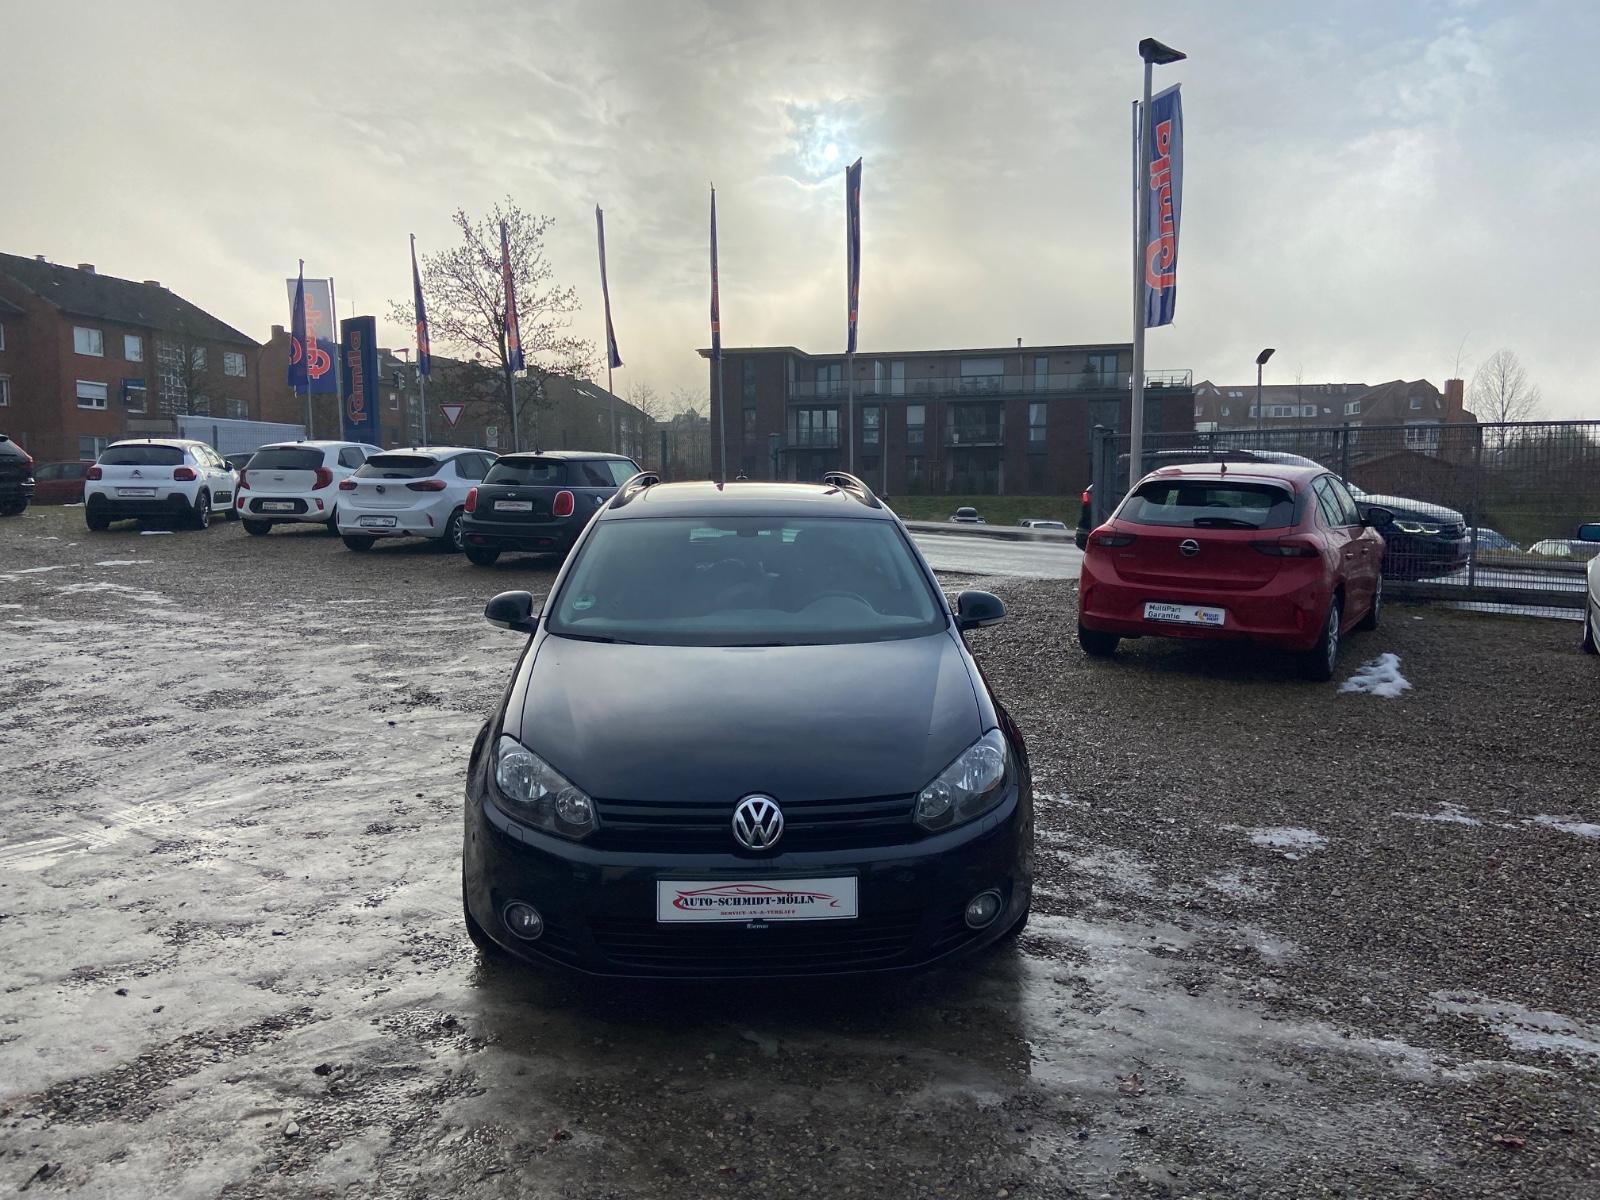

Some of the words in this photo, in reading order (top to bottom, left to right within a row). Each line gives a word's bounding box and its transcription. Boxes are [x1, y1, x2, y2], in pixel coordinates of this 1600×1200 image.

[348, 332, 368, 425] famila
[1148, 611, 1181, 619] Garantie
[681, 893, 816, 907] AUTO-SCHMIDT-MÖLLN
